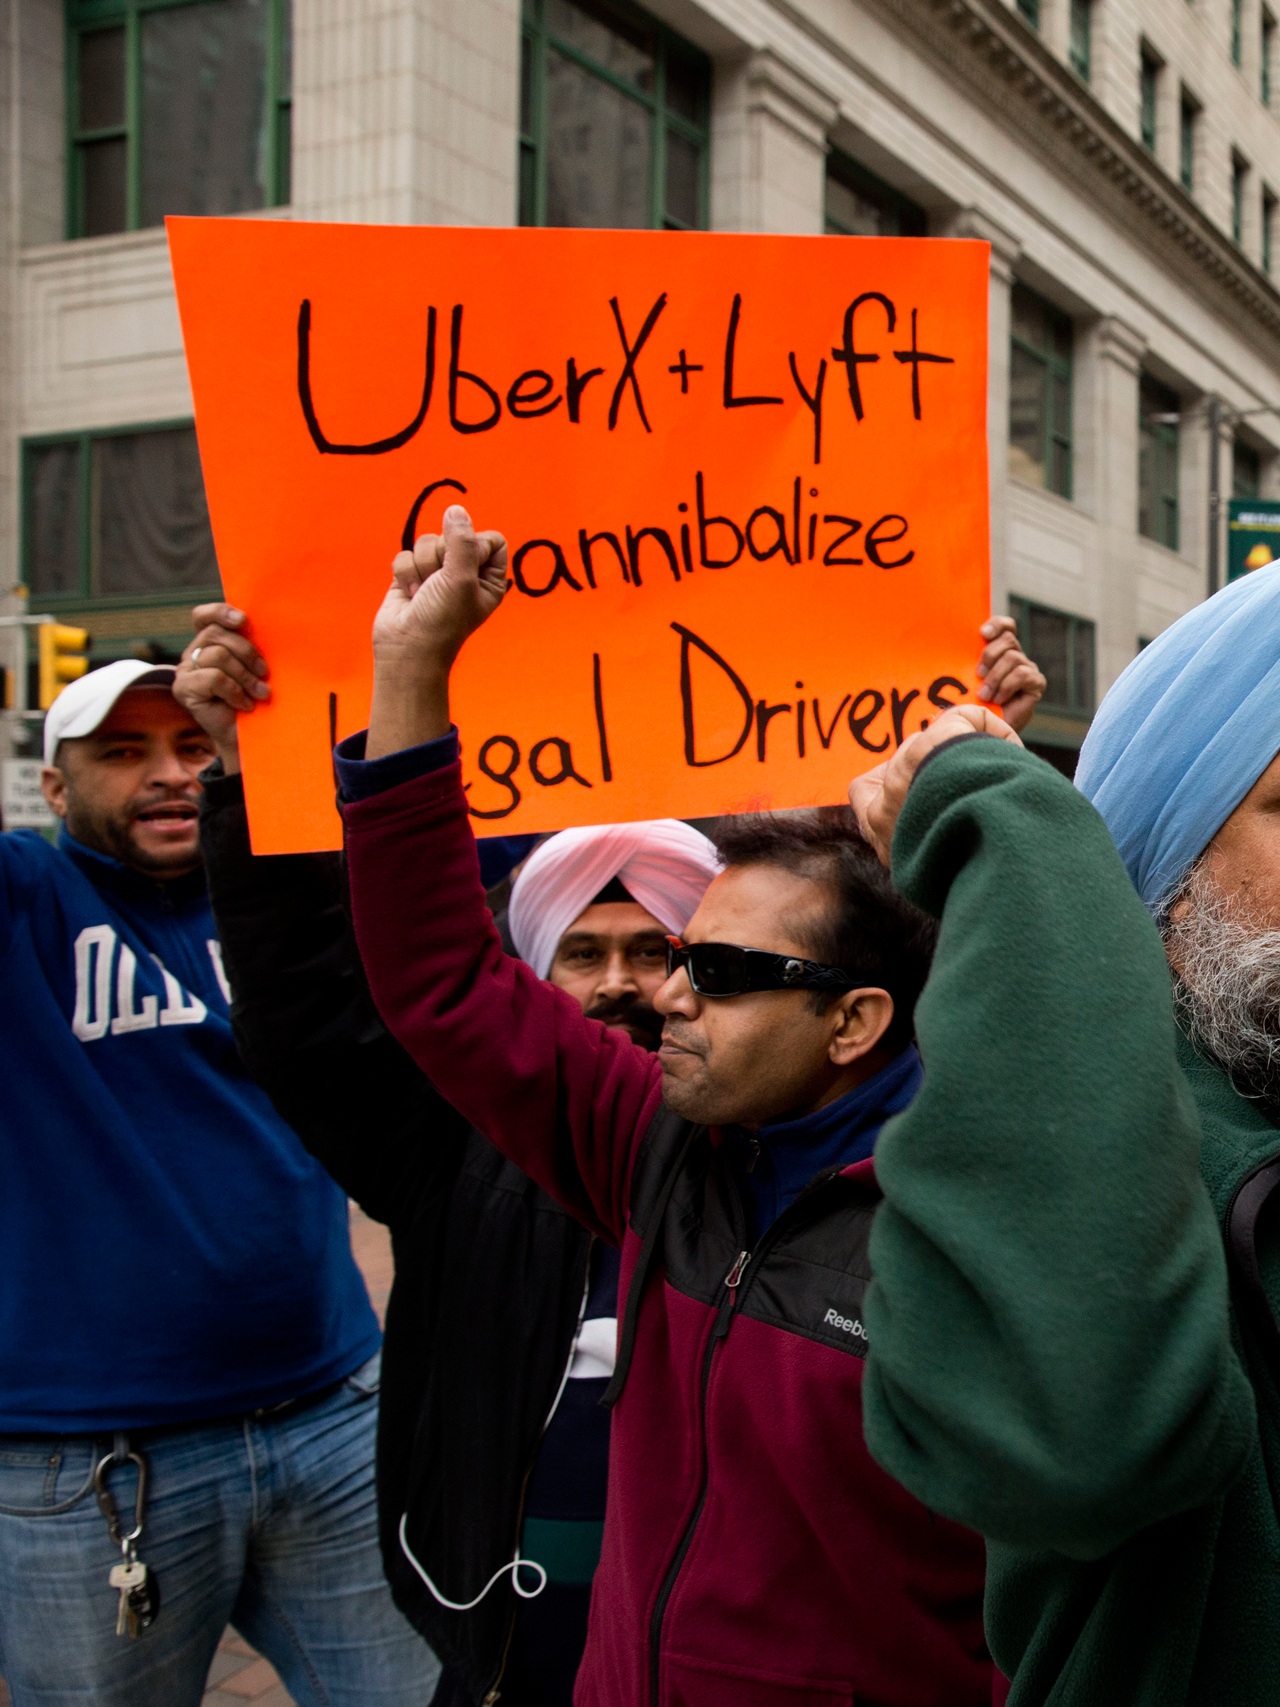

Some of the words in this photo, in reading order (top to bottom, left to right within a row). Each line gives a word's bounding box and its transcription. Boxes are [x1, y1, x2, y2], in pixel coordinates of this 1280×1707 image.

[723, 291, 955, 465] Lyft
[329, 652, 612, 820] Lgal
[669, 621, 969, 768] Drivers
